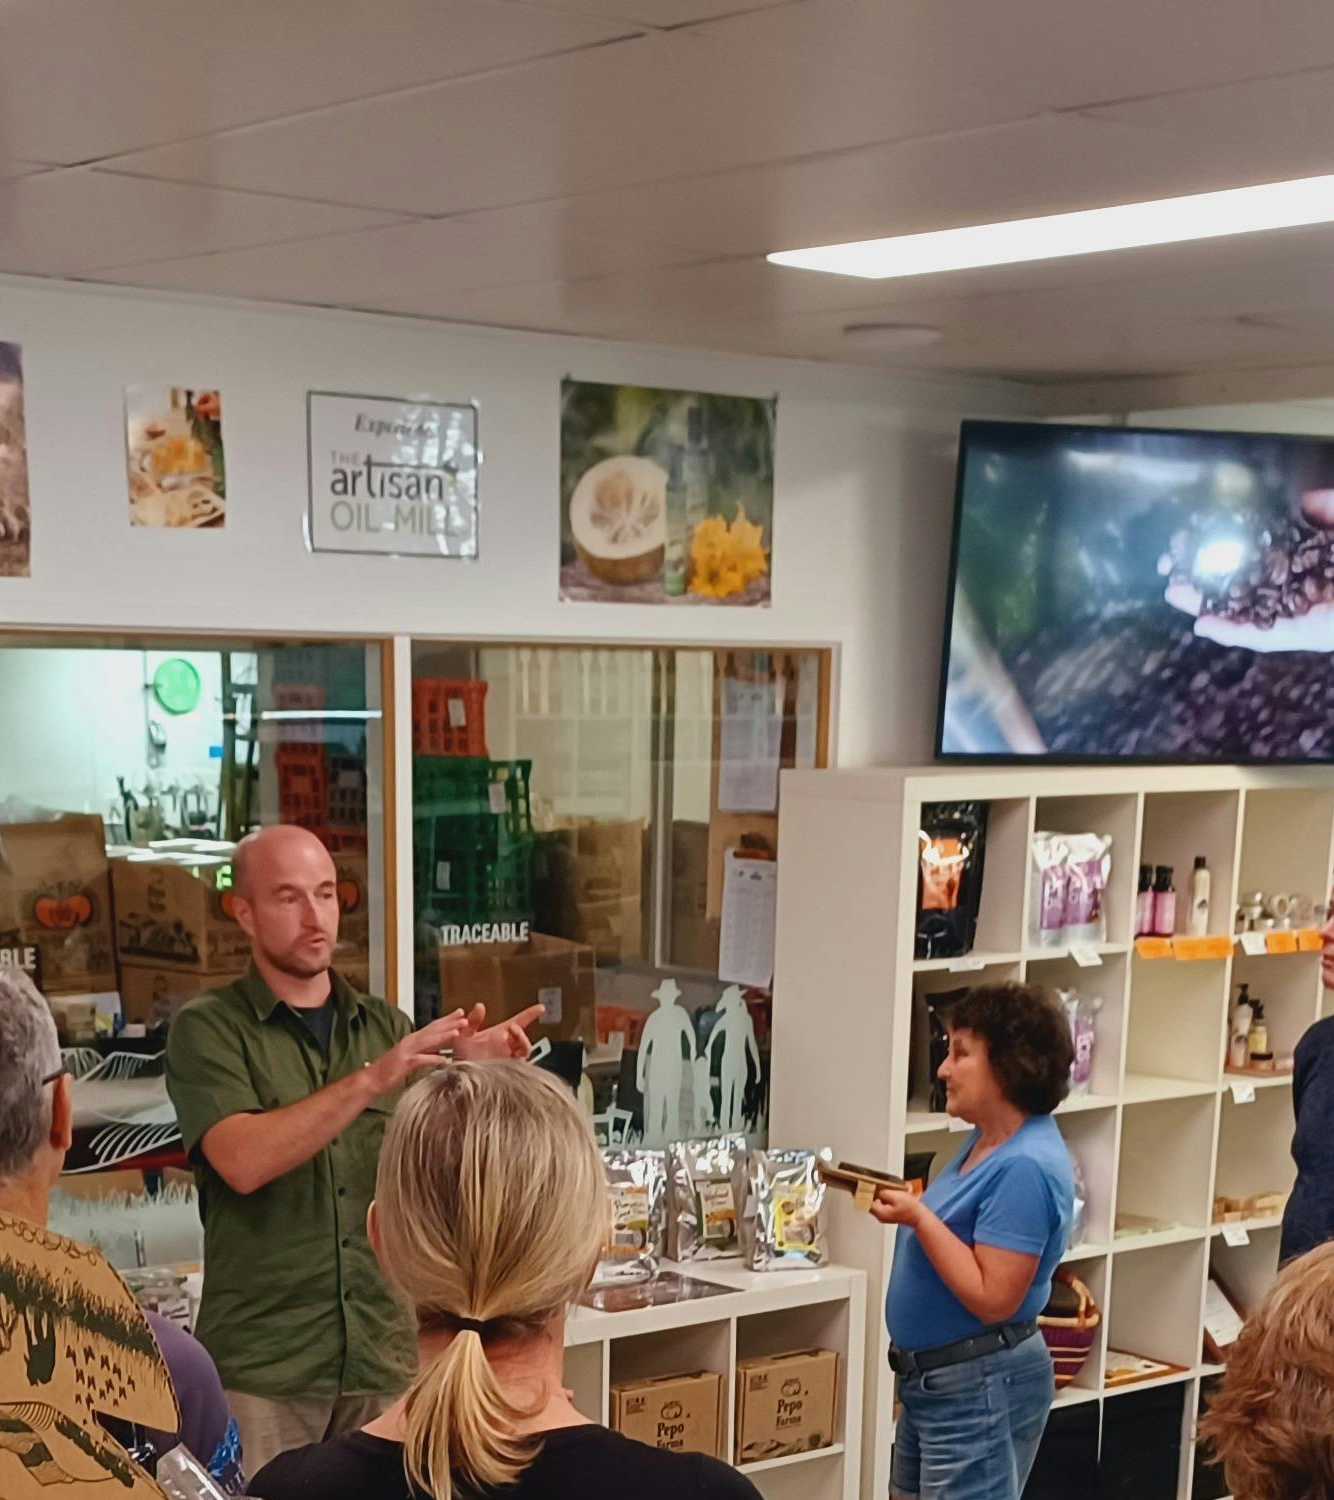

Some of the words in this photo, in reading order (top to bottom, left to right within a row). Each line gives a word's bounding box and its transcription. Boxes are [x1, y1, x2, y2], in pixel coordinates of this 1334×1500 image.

[330, 455, 444, 501] artisan
[330, 500, 381, 533] OIL
[440, 921, 530, 945] TRACEABLE
[775, 1398, 804, 1416] Pepo
[657, 1421, 685, 1440] Pepo
